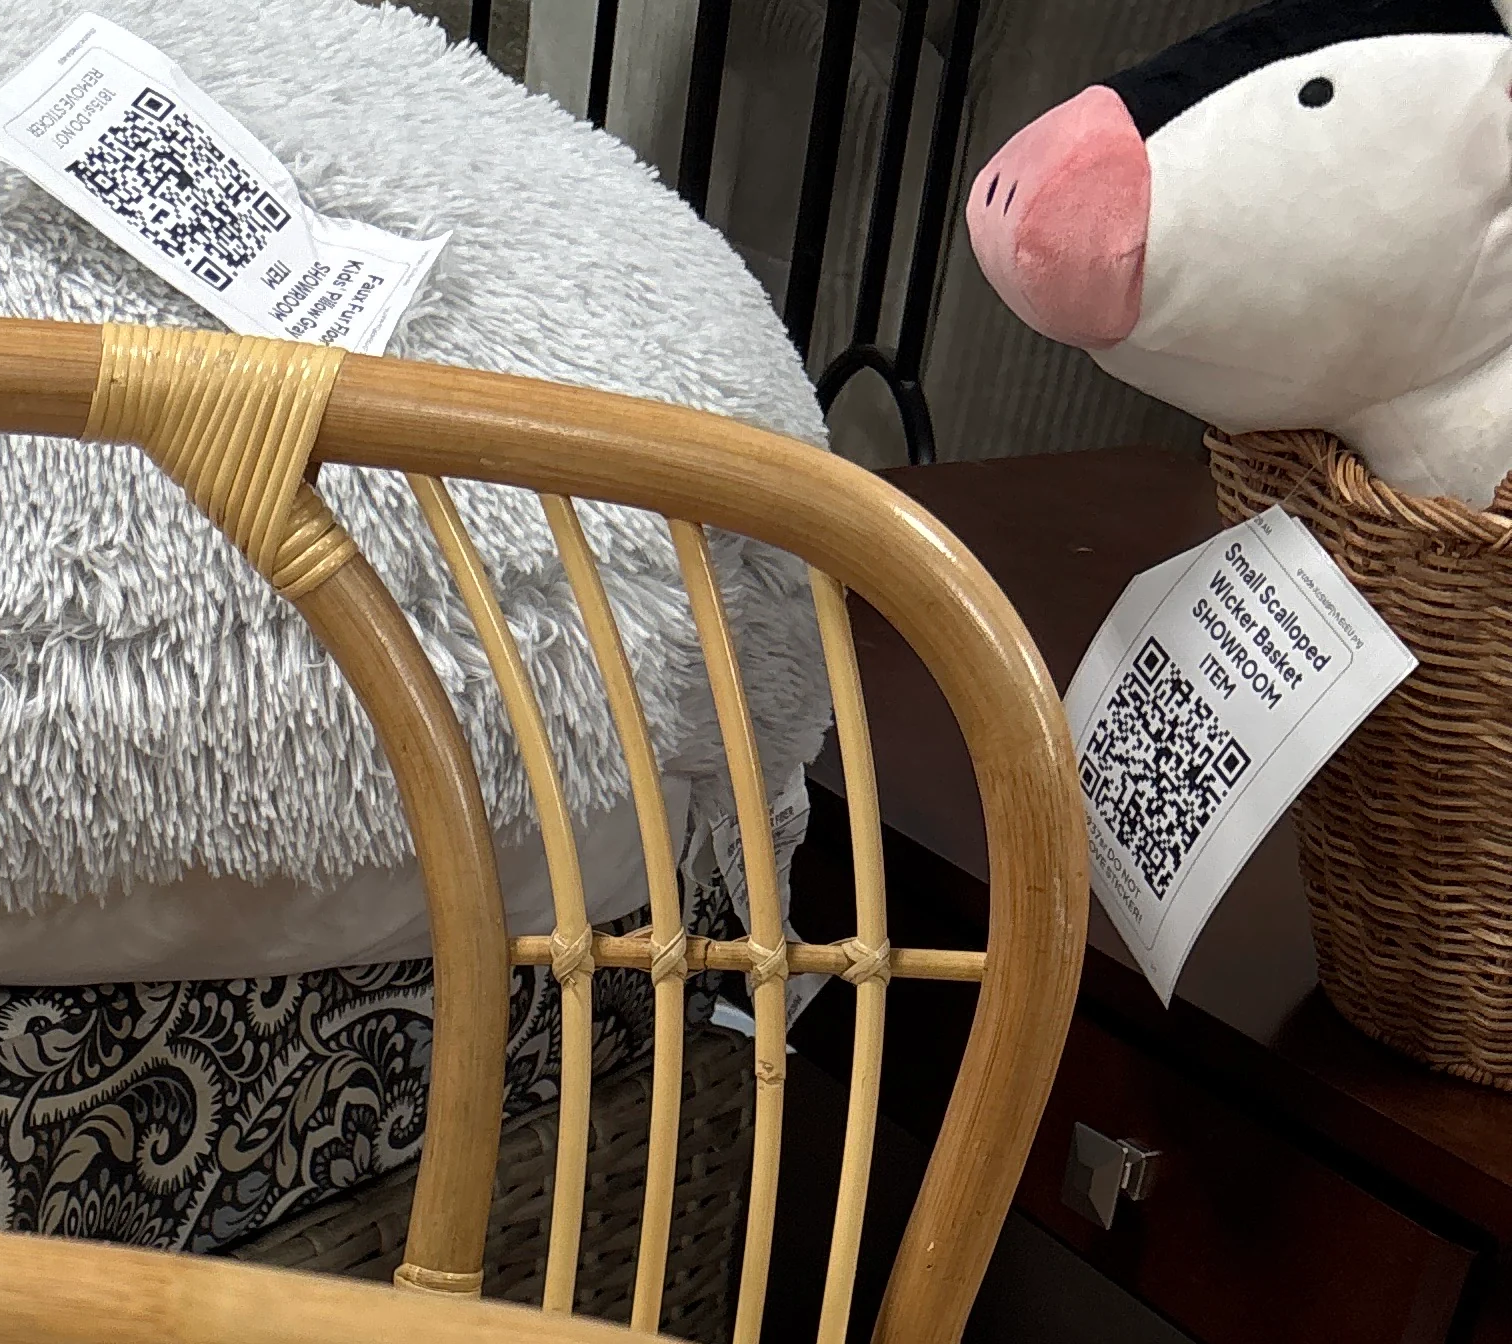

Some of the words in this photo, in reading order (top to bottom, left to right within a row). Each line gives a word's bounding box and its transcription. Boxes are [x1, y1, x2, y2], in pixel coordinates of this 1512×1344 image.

[59, 67, 104, 111] REMOVE
[51, 125, 76, 150] NOT
[70, 112, 91, 132] DO
[260, 259, 292, 291] ITEM
[351, 274, 385, 304] Faux
[268, 261, 331, 323] SHOWROOM
[307, 290, 344, 320] Pillow
[284, 317, 318, 340] Gray
[338, 302, 365, 325] Fur
[1224, 541, 1267, 595] Small
[1259, 585, 1333, 673] Scalloped
[1209, 568, 1259, 634] Wicker
[1252, 624, 1304, 691] Basket
[1192, 598, 1283, 711] SHOWROOM
[1198, 652, 1238, 701] ITEM
[1088, 839, 1107, 870] OVE
[1107, 847, 1122, 872] DO
[1121, 868, 1141, 899] NOT
